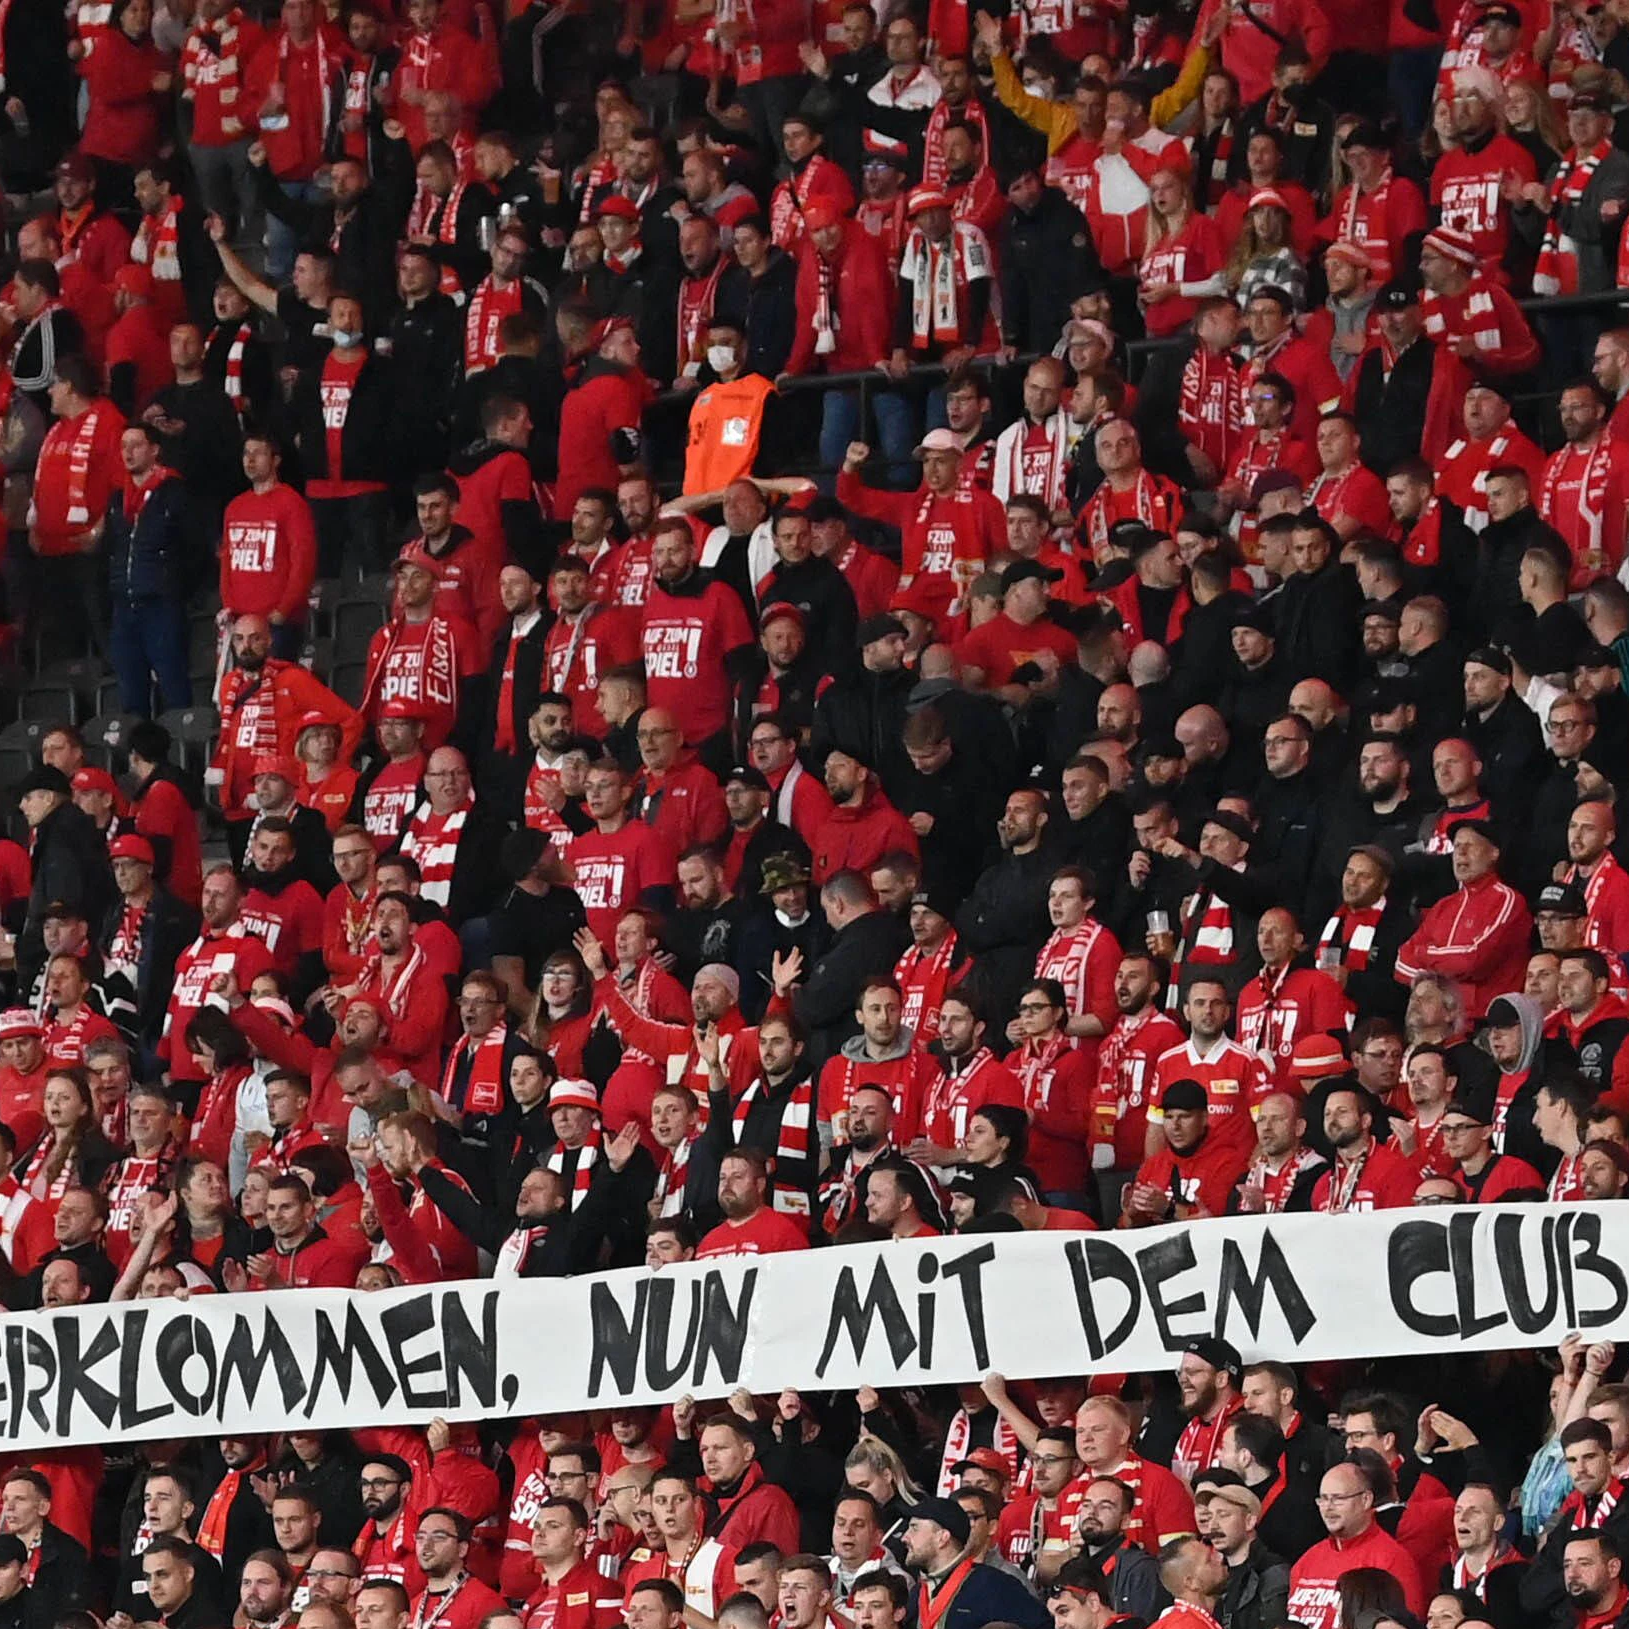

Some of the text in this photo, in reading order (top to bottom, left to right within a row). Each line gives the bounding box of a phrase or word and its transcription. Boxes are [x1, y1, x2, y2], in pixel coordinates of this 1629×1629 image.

[587, 1268, 758, 1398] NUN
[1064, 1228, 1316, 1361] DEM
[1388, 1211, 1628, 1340] CLUB
